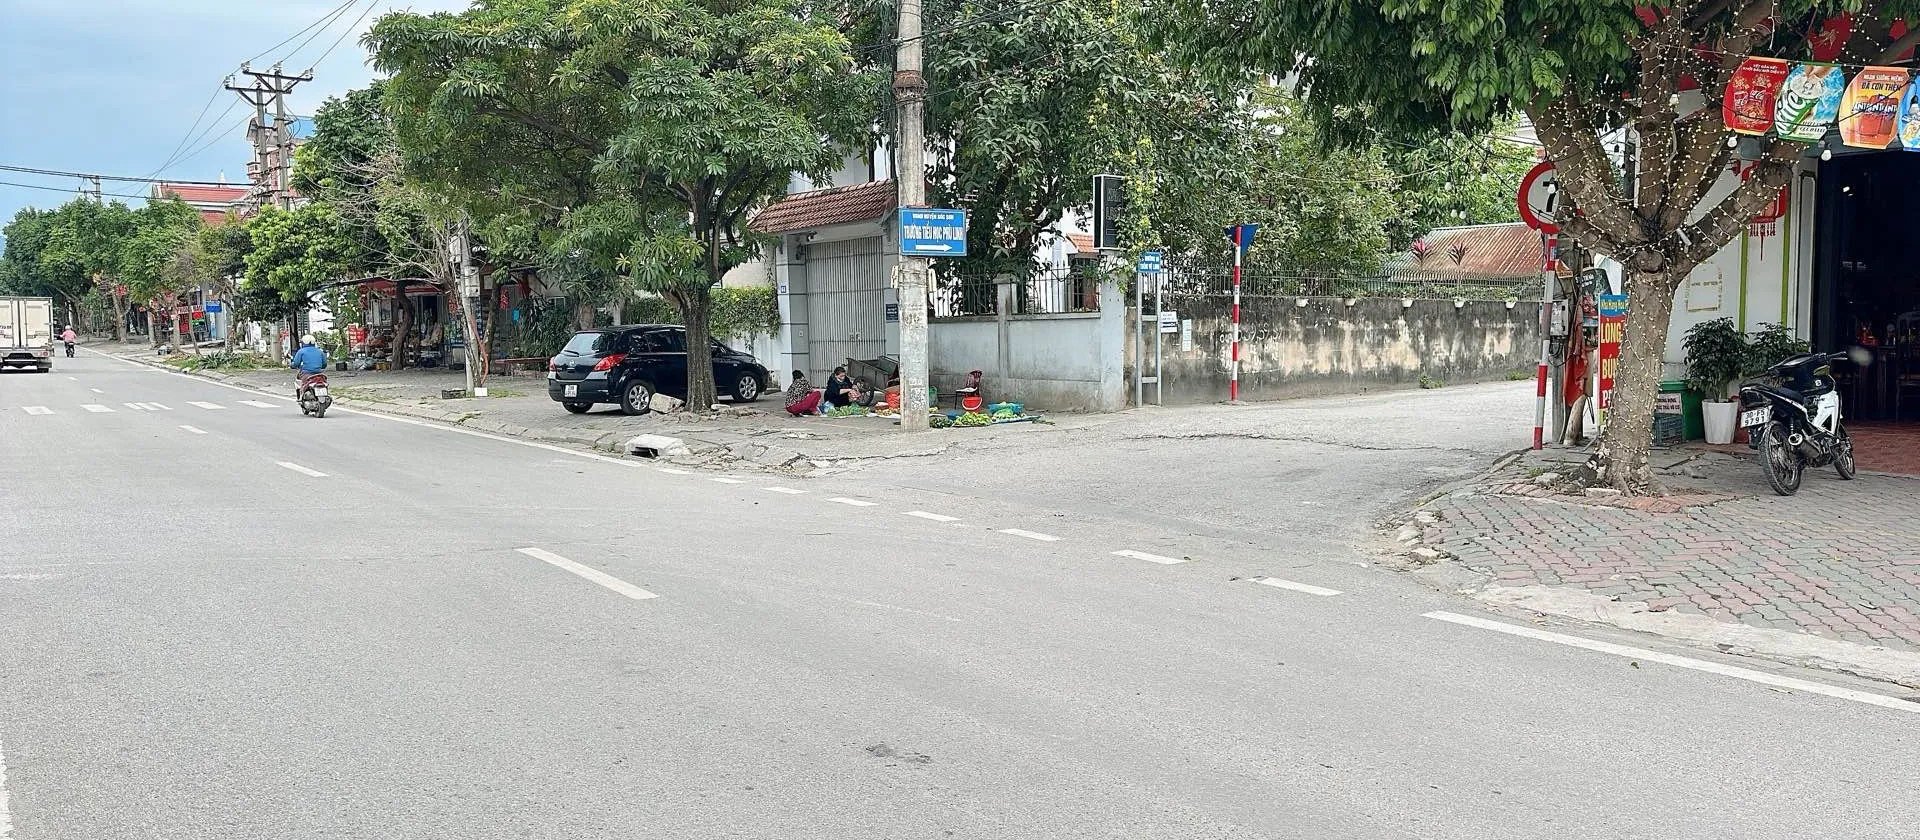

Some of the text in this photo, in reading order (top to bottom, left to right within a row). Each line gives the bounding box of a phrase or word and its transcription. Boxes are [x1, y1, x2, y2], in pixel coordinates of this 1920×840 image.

[904, 223, 922, 240] TRƯỜNG
[922, 220, 932, 240] TIỂU
[932, 226, 942, 243] HỌC
[1600, 317, 1622, 344] LÒNG
